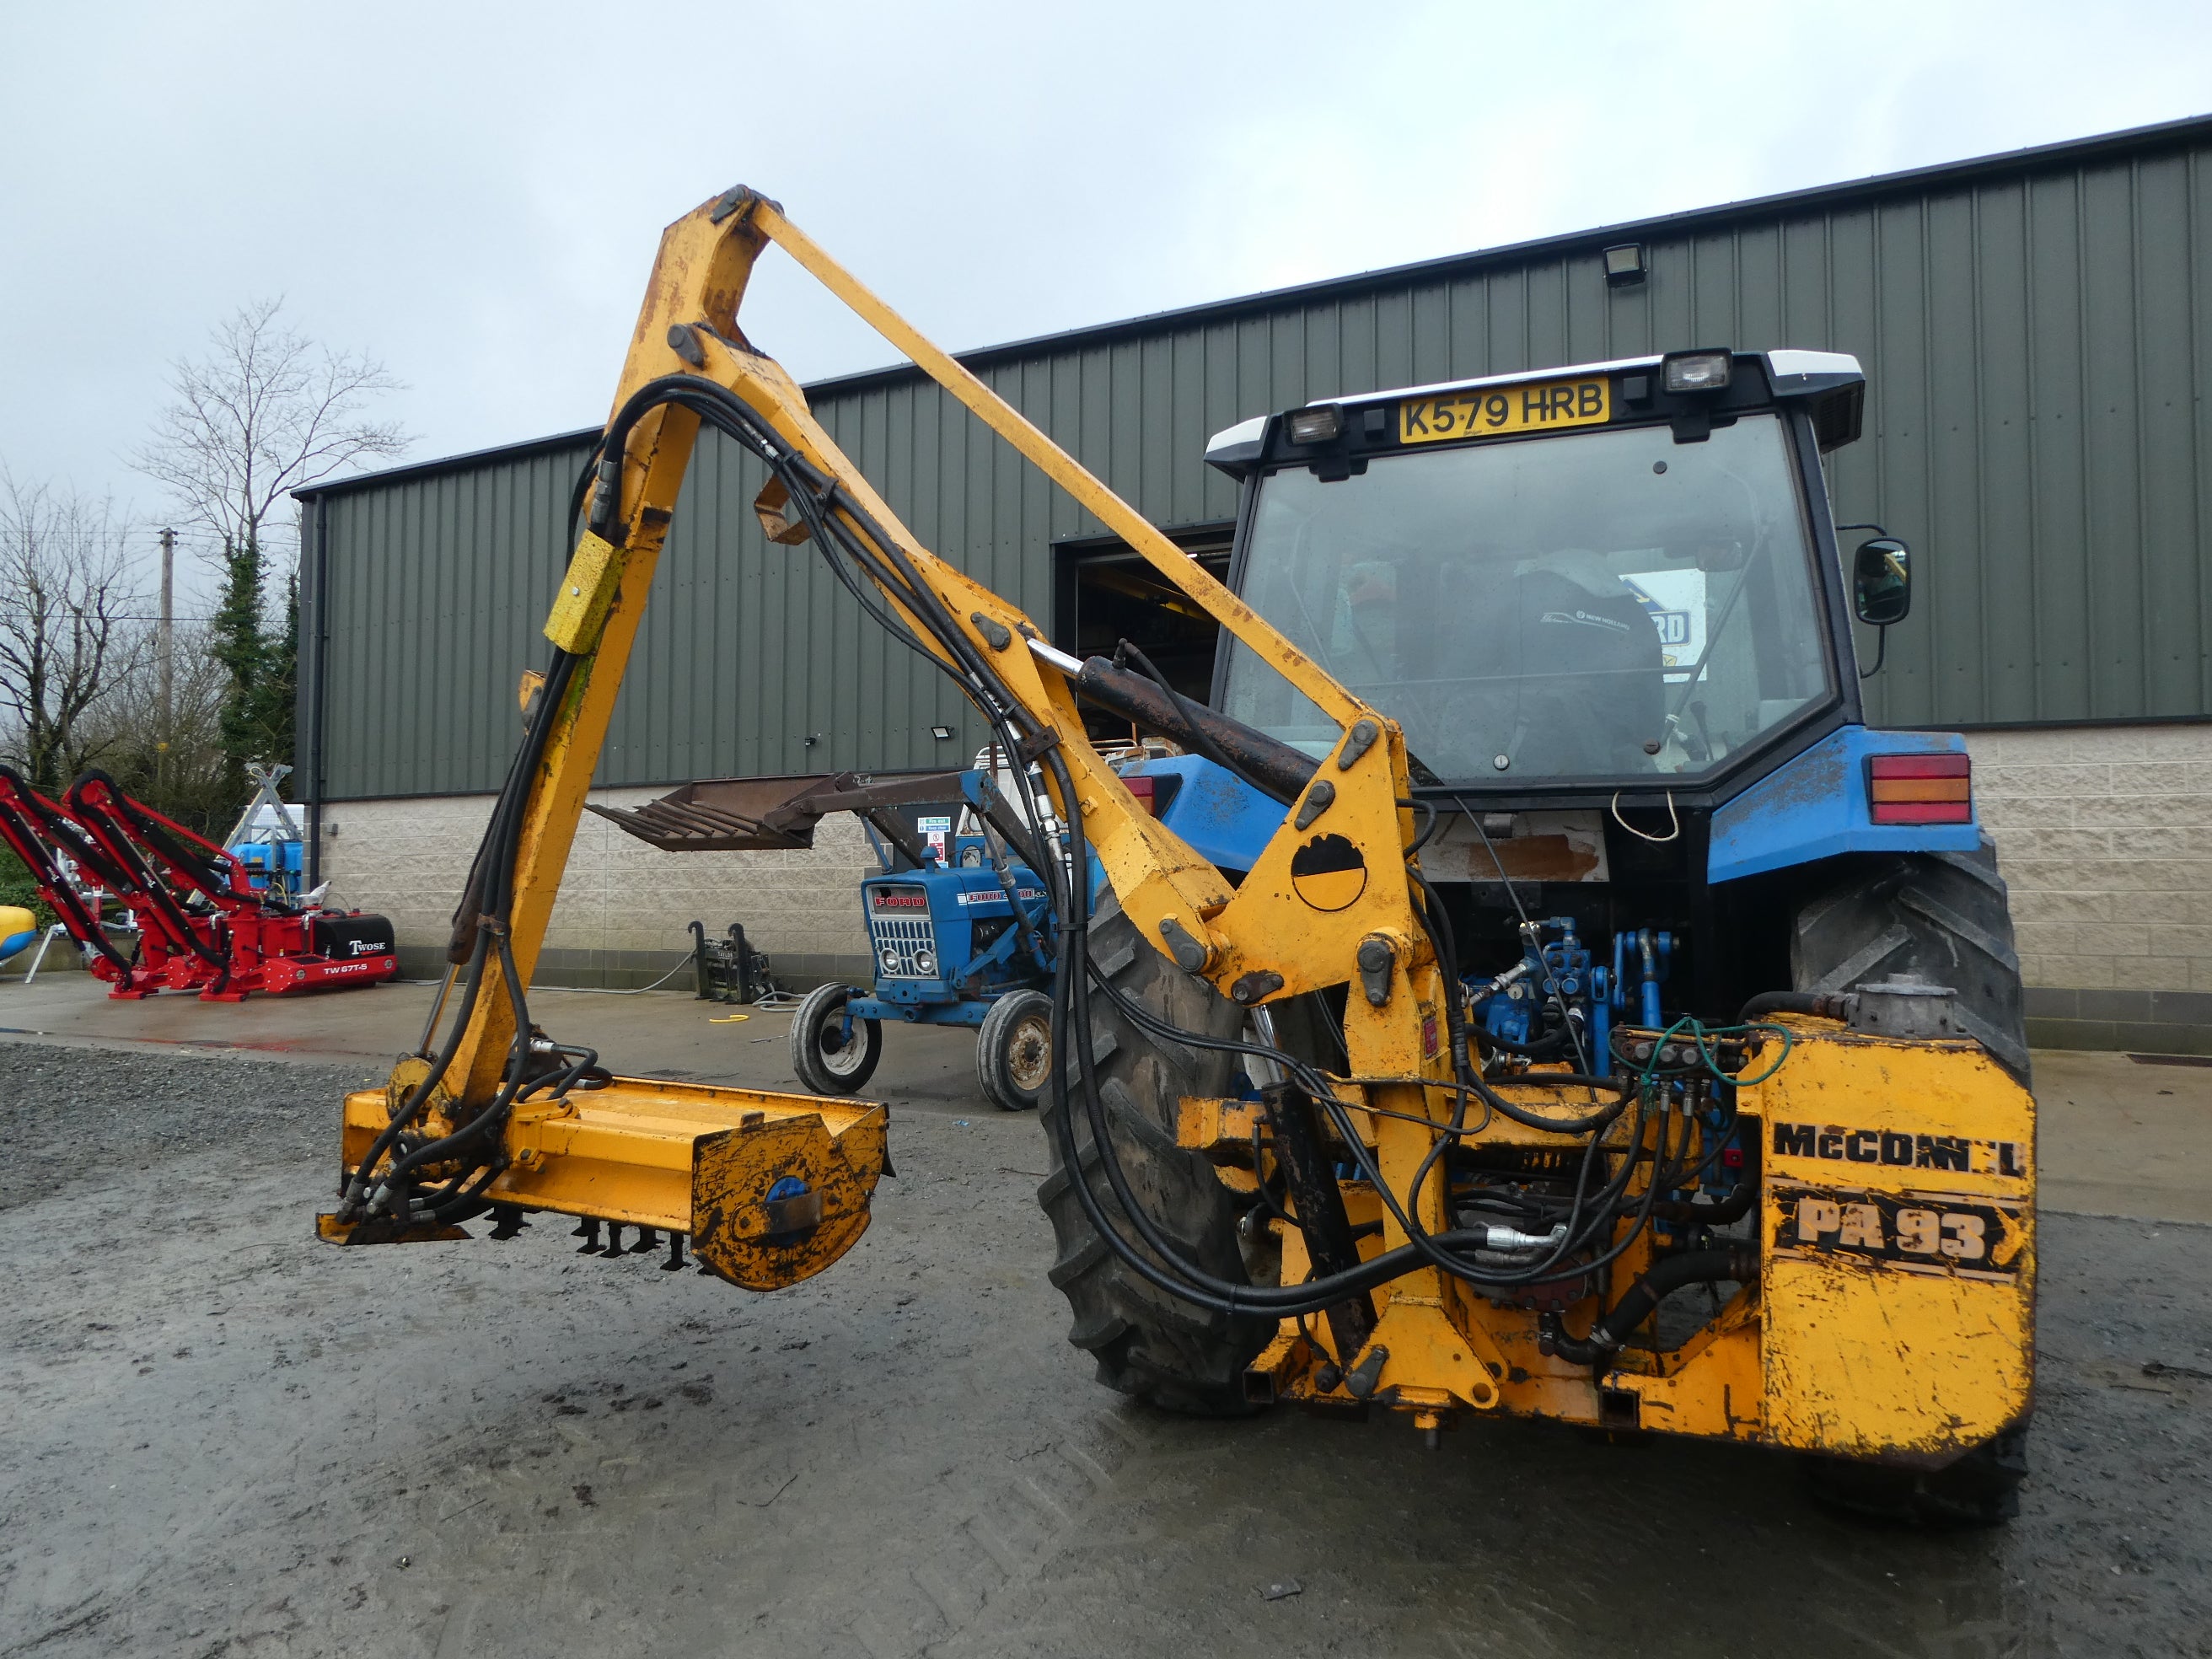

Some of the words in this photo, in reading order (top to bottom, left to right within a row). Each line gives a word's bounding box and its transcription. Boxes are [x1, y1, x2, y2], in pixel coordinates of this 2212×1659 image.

[1405, 394, 1509, 437] K579
[1522, 384, 1603, 424] HRB
[1586, 614, 1602, 623] NEW
[1651, 615, 1685, 643] RD
[874, 896, 926, 908] FORD
[969, 892, 1001, 903] FORD
[1002, 889, 1033, 900] 400
[324, 966, 341, 974] TW
[1773, 1122, 2025, 1178] McCONNL
[1797, 1197, 1886, 1249] PA
[1896, 1207, 1985, 1259] 93
